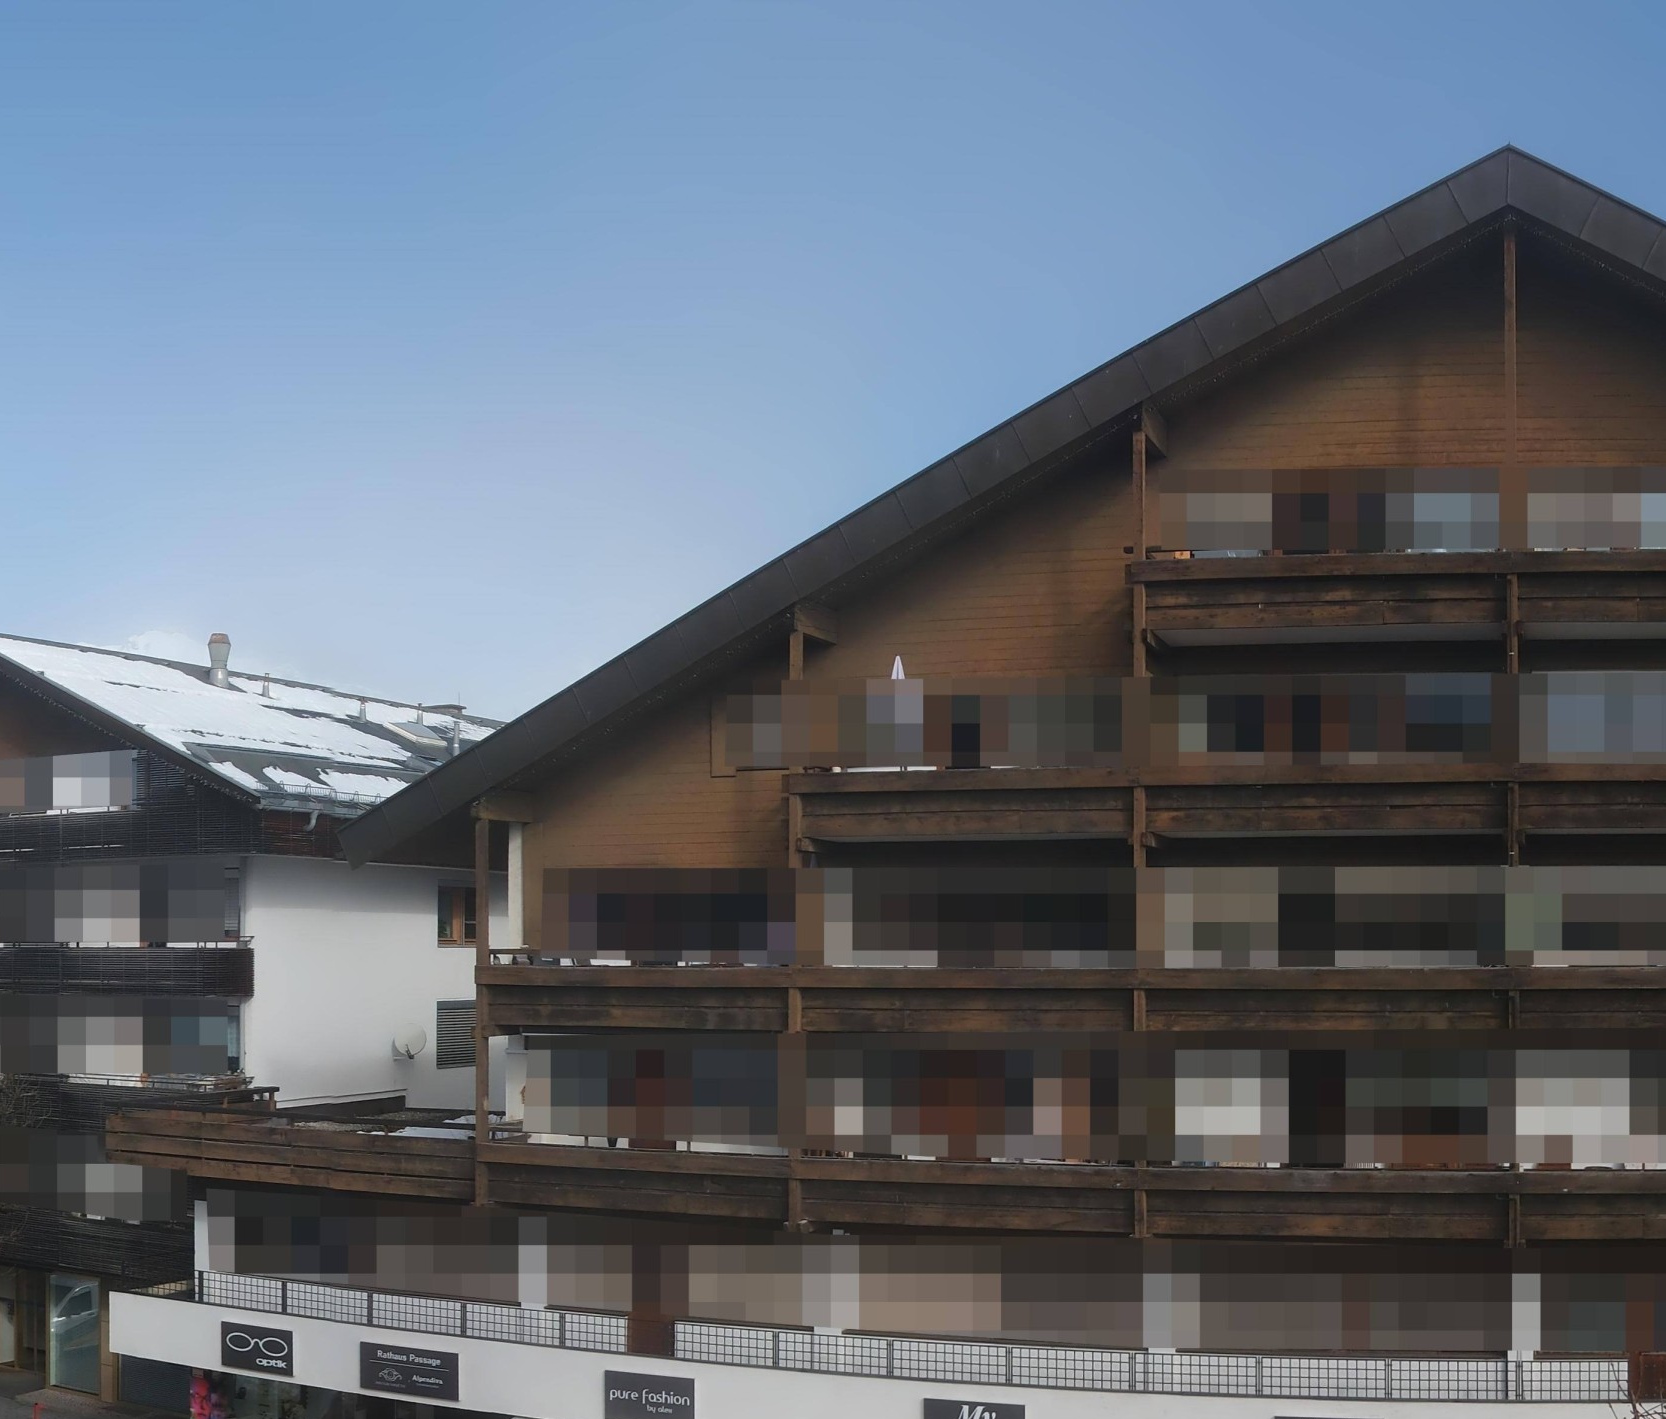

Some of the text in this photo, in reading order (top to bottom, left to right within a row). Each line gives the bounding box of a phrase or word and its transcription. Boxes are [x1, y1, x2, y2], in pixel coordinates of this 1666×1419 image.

[256, 1357, 287, 1369] optik
[377, 1350, 442, 1366] Rathaus Passage
[609, 1388, 690, 1406] pure fashion
[646, 1404, 656, 1413] by
